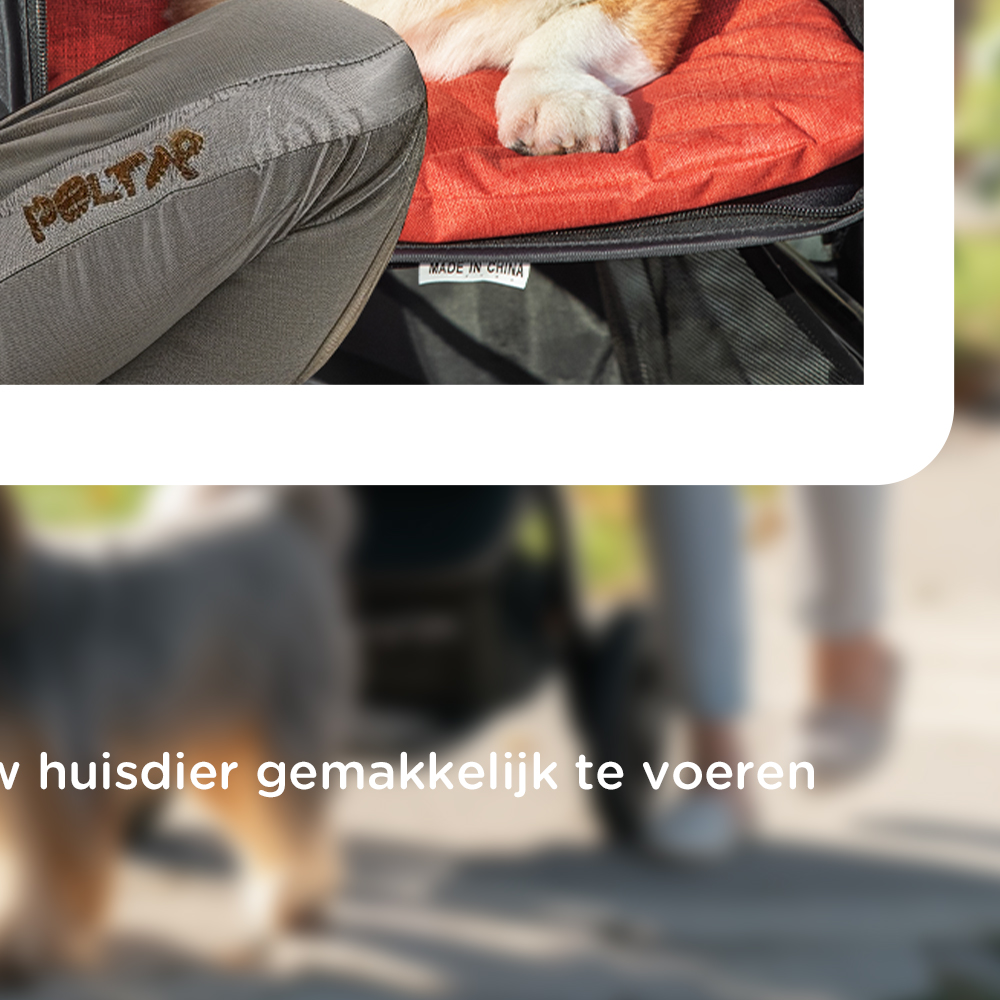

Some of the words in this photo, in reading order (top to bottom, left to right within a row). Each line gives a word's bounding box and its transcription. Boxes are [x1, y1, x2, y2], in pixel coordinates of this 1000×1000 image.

[428, 262, 464, 275] MADE
[469, 262, 482, 274] IN
[486, 262, 524, 278] CHINA
